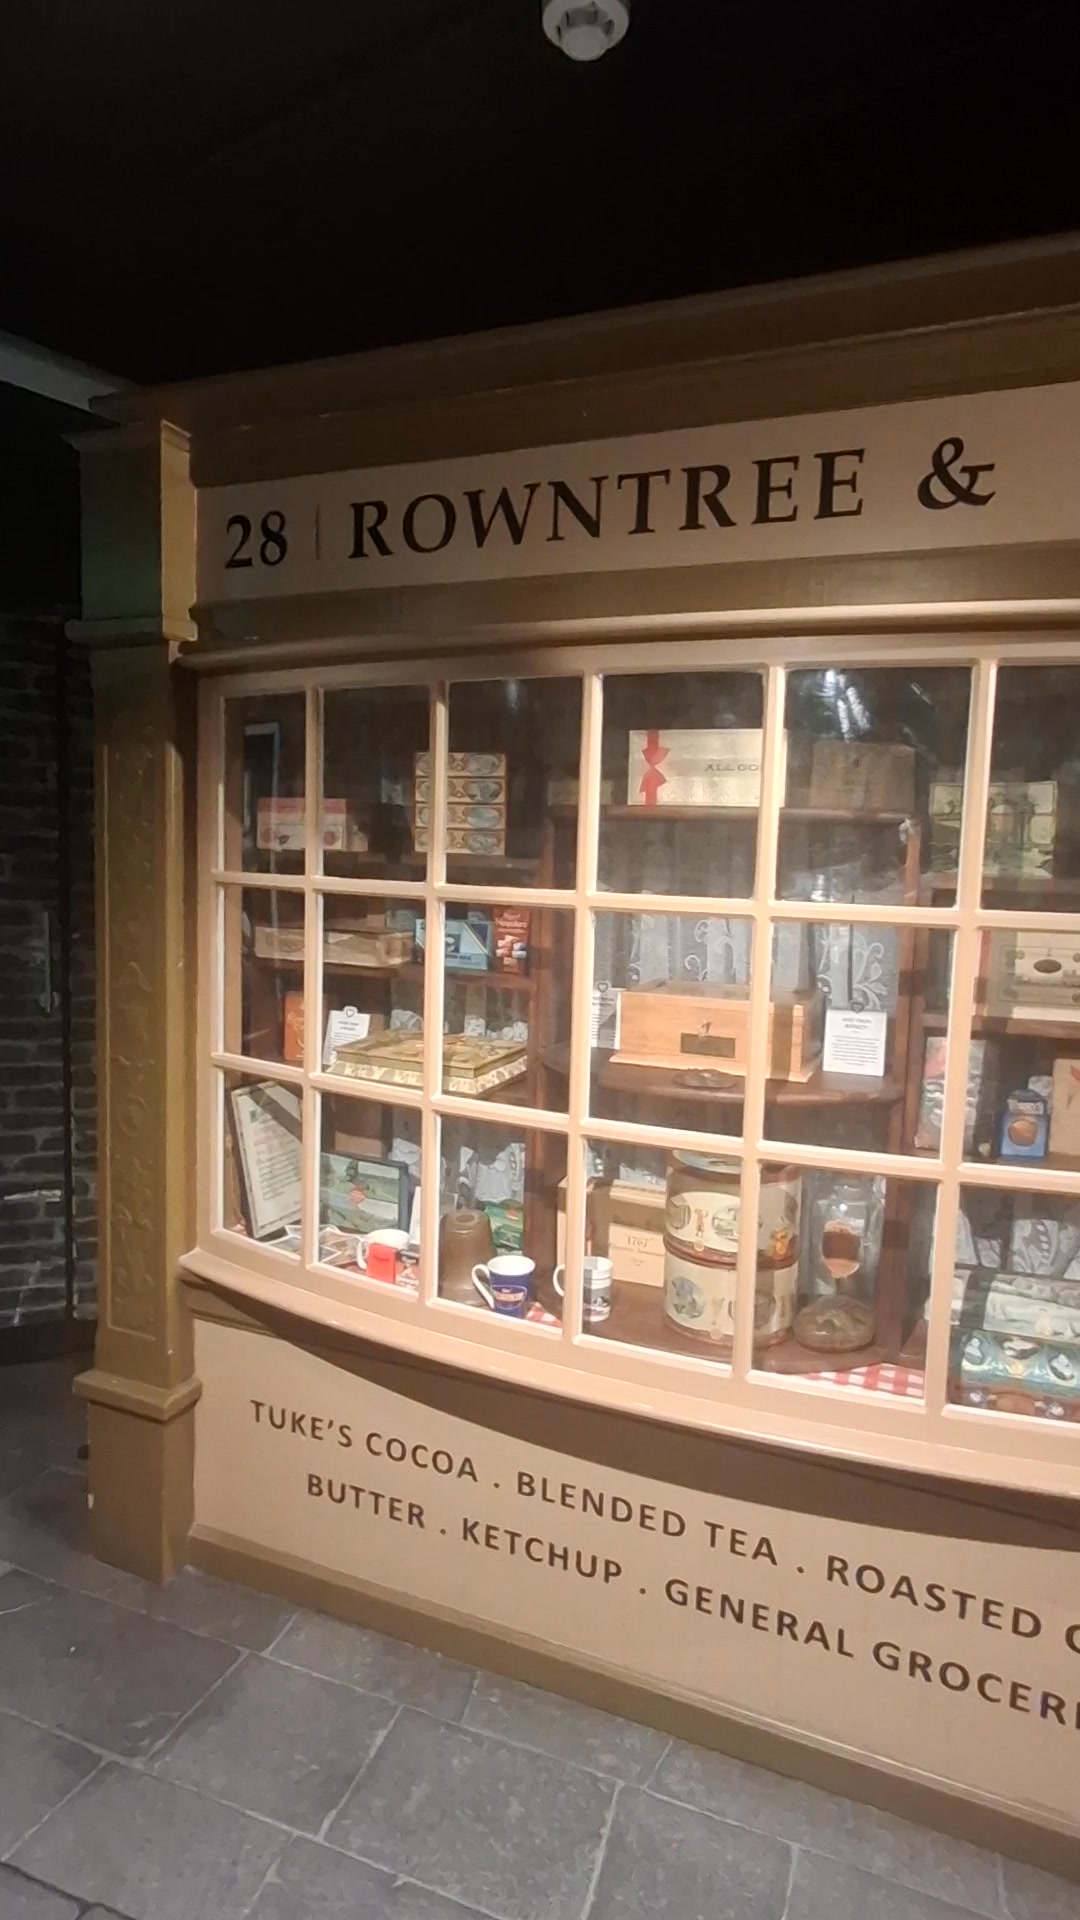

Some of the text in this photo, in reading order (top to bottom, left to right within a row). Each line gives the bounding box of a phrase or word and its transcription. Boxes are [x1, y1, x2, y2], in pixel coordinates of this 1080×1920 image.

[223, 436, 997, 571] 28 ROWNTREE &
[249, 1399, 353, 1449] TUKE'S
[365, 1432, 479, 1483] COCOA
[517, 1470, 686, 1538] BLENDED
[703, 1520, 778, 1567] TEA
[826, 1554, 1042, 1640] ROASTED
[307, 1473, 426, 1530] BUTTER
[462, 1517, 623, 1585] KETCHUP
[664, 1578, 855, 1659] GENERAL
